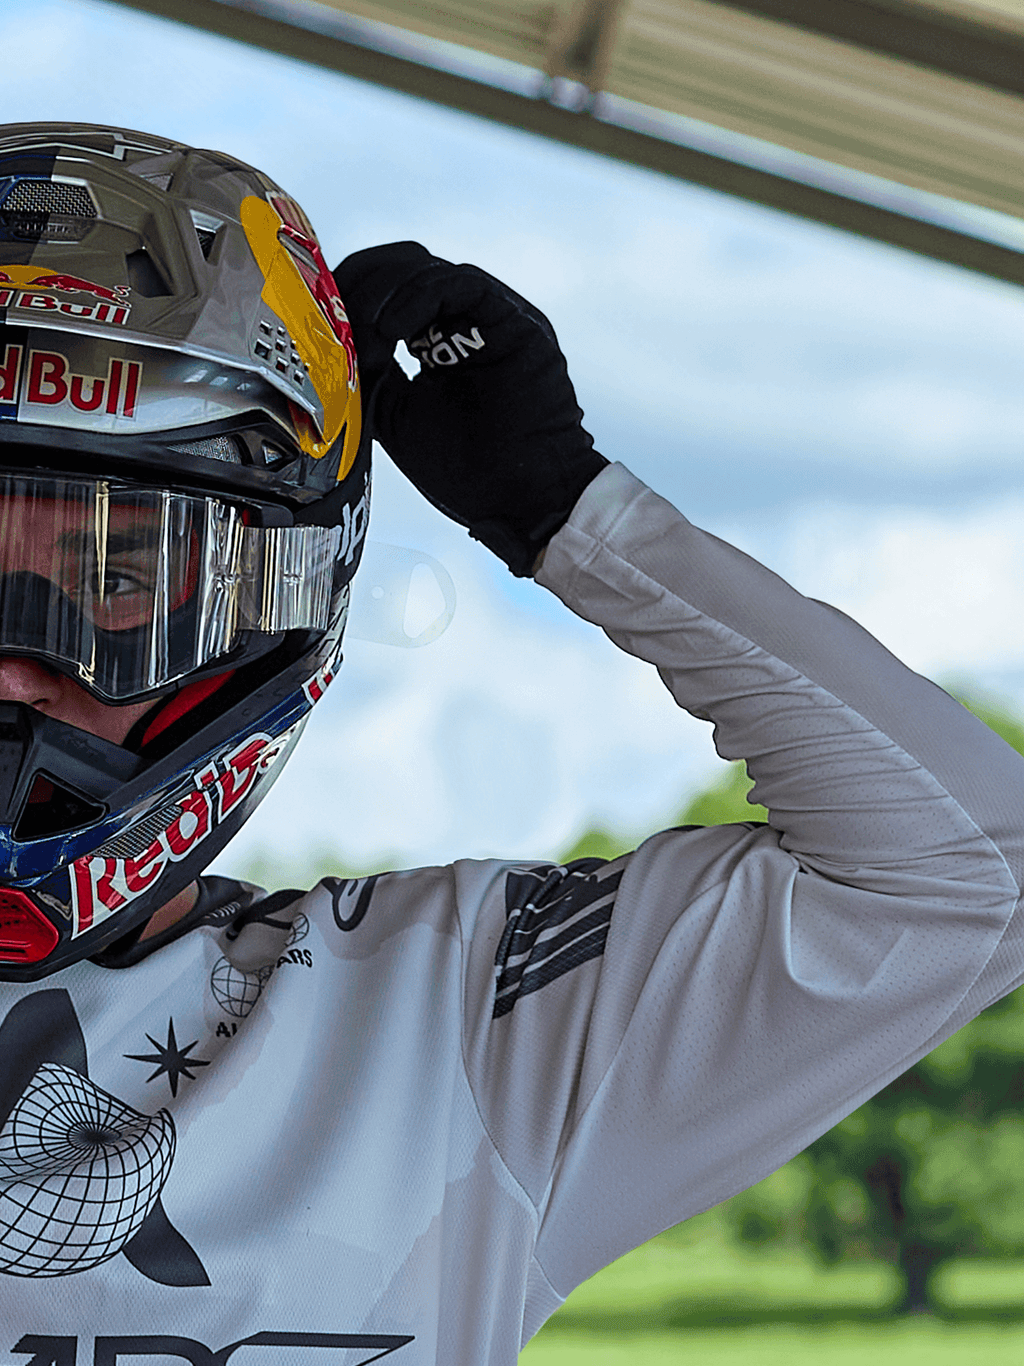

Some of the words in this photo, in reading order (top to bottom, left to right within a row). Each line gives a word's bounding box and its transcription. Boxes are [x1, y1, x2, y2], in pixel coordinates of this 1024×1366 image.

[14, 292, 131, 325] Bull
[23, 349, 144, 420] Bull
[68, 761, 220, 941] Red
